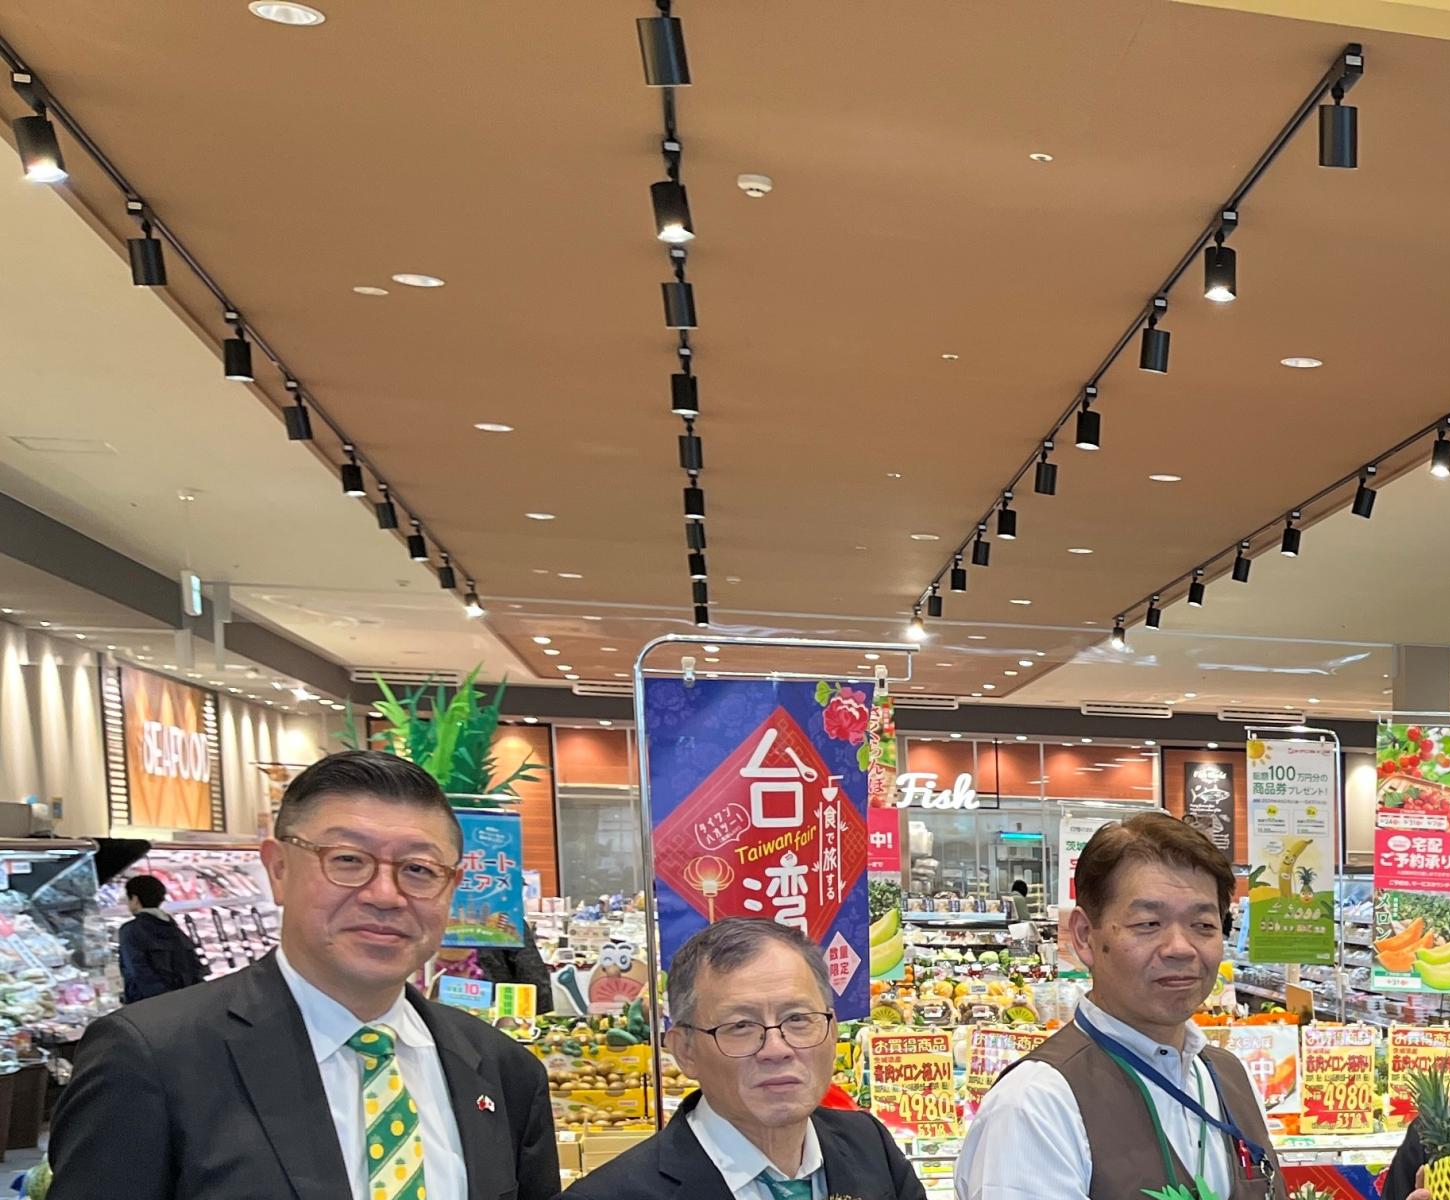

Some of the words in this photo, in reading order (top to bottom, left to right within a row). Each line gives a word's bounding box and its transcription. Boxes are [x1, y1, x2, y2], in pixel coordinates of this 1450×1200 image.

[143, 719, 211, 783] SEAFOOD
[895, 772, 980, 811] Fish
[734, 832, 793, 864] Taiwan
[794, 825, 817, 851] fair
[822, 804, 838, 901] 食で旅する
[869, 831, 893, 849] 中!
[1411, 837, 1443, 853] 宅配
[459, 849, 516, 874] ポート
[1374, 892, 1392, 941] メロン
[875, 1038, 947, 1053] お買得商品
[899, 1092, 951, 1122] 4980
[1323, 1082, 1370, 1111] 4980
